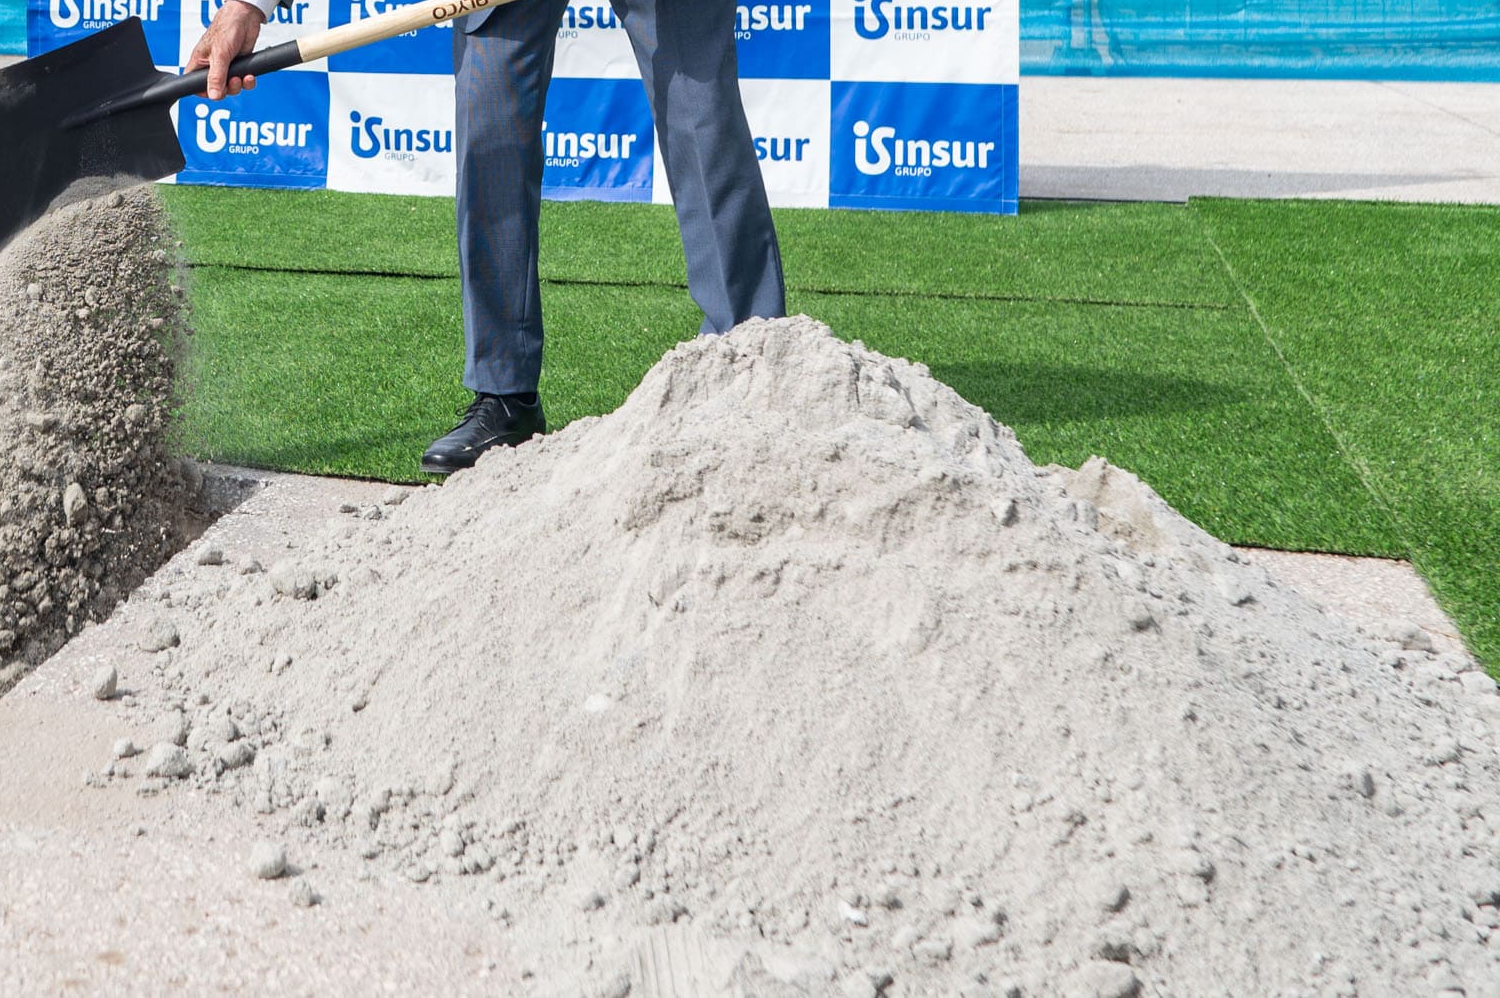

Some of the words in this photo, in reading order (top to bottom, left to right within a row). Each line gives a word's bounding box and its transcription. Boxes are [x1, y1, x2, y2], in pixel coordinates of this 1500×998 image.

[894, 32, 931, 41] GRUPO
[228, 145, 260, 155] GRUPO
[385, 152, 415, 162] GRUPO
[545, 157, 580, 168] GRUPO
[894, 166, 932, 176] GRUPO
